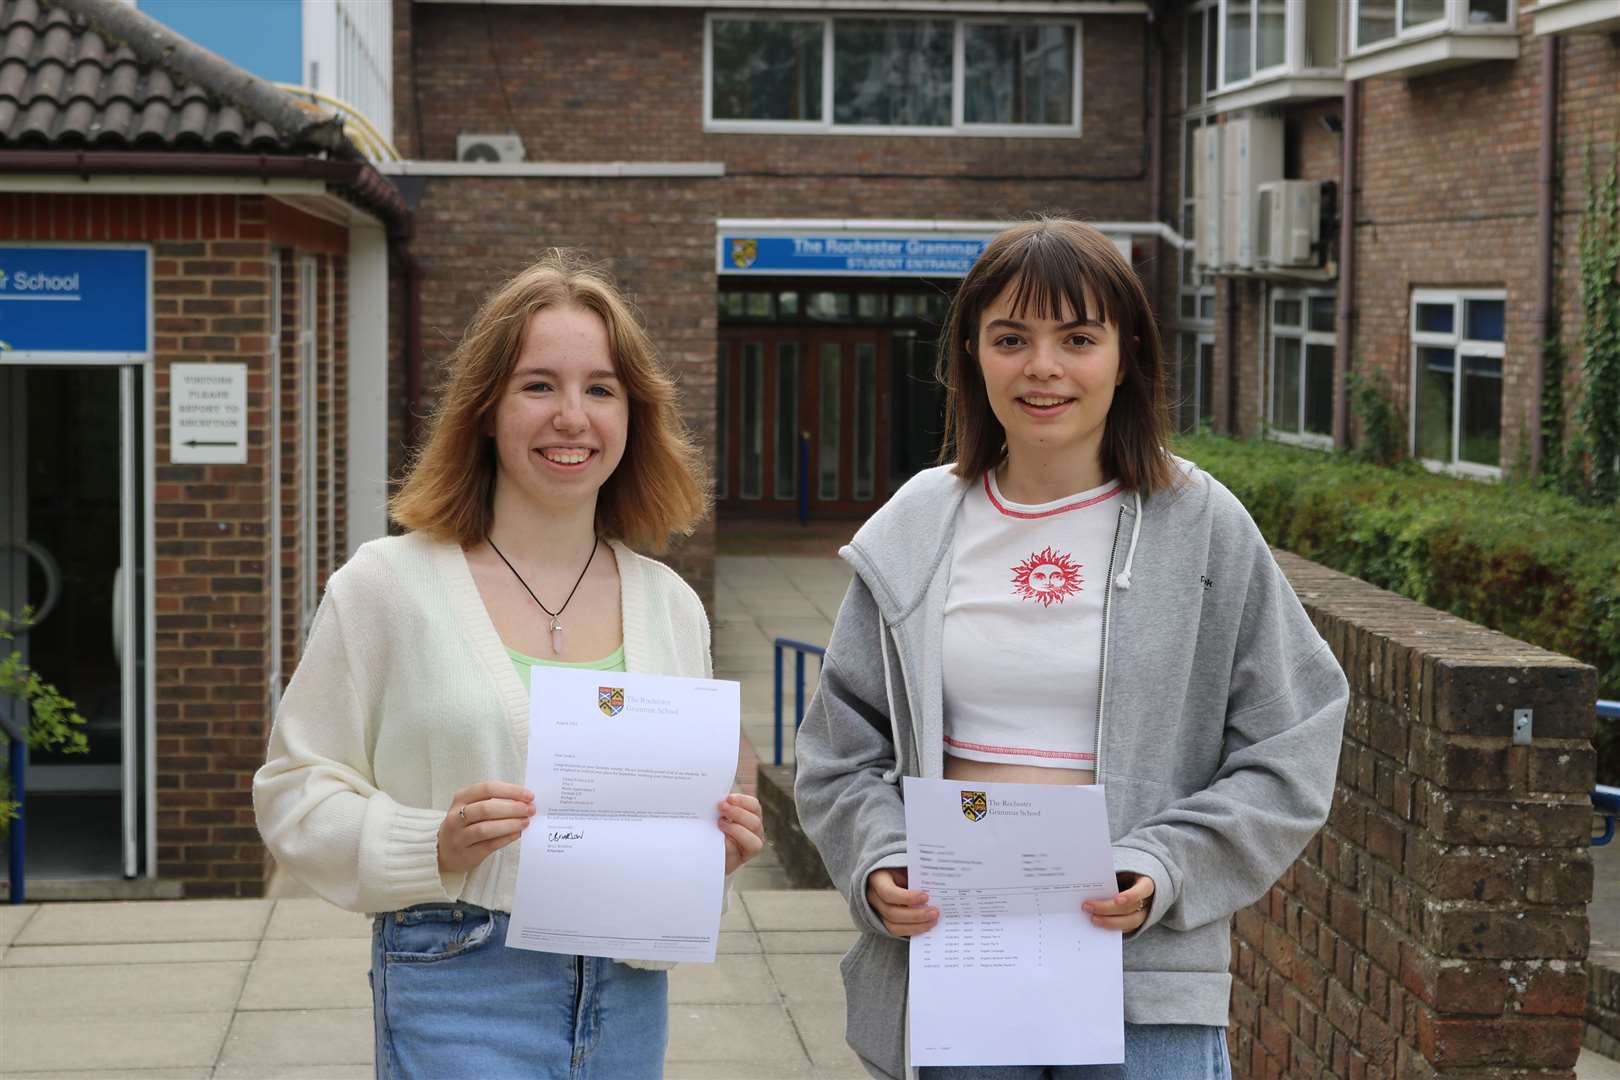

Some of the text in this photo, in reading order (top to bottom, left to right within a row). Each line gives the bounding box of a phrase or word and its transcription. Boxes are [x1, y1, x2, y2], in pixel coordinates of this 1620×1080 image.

[793, 239, 823, 254] The
[825, 239, 903, 255] Rochester
[905, 240, 979, 256] Grammar
[846, 257, 970, 271] STUDENT ENTRANCE
[13, 270, 80, 291] School
